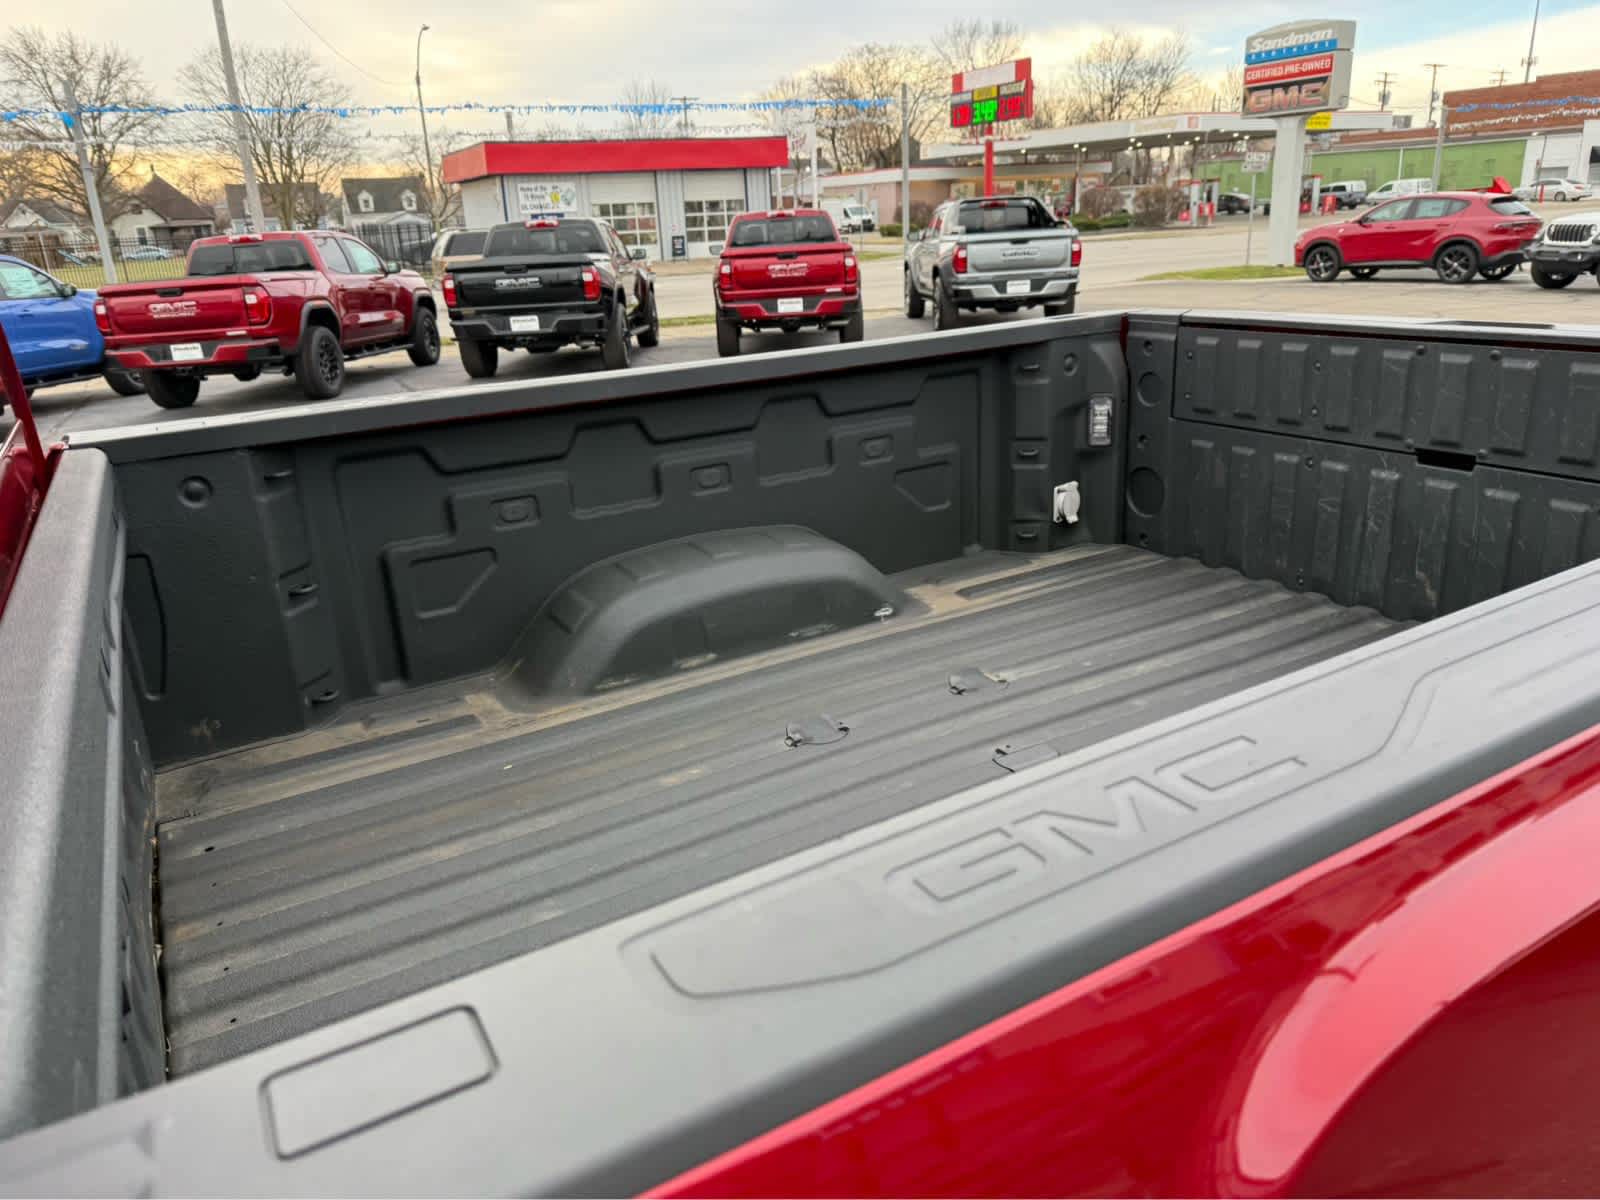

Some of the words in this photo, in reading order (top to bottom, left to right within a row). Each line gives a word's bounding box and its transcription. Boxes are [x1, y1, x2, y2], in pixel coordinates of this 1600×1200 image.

[1250, 29, 1333, 53] Sandman
[1246, 68, 1284, 81] CERTIFIED
[1285, 58, 1331, 75] PRE-OWNED
[1248, 81, 1323, 112] GMC
[148, 301, 197, 313] GMC
[883, 735, 1307, 906] GMC
